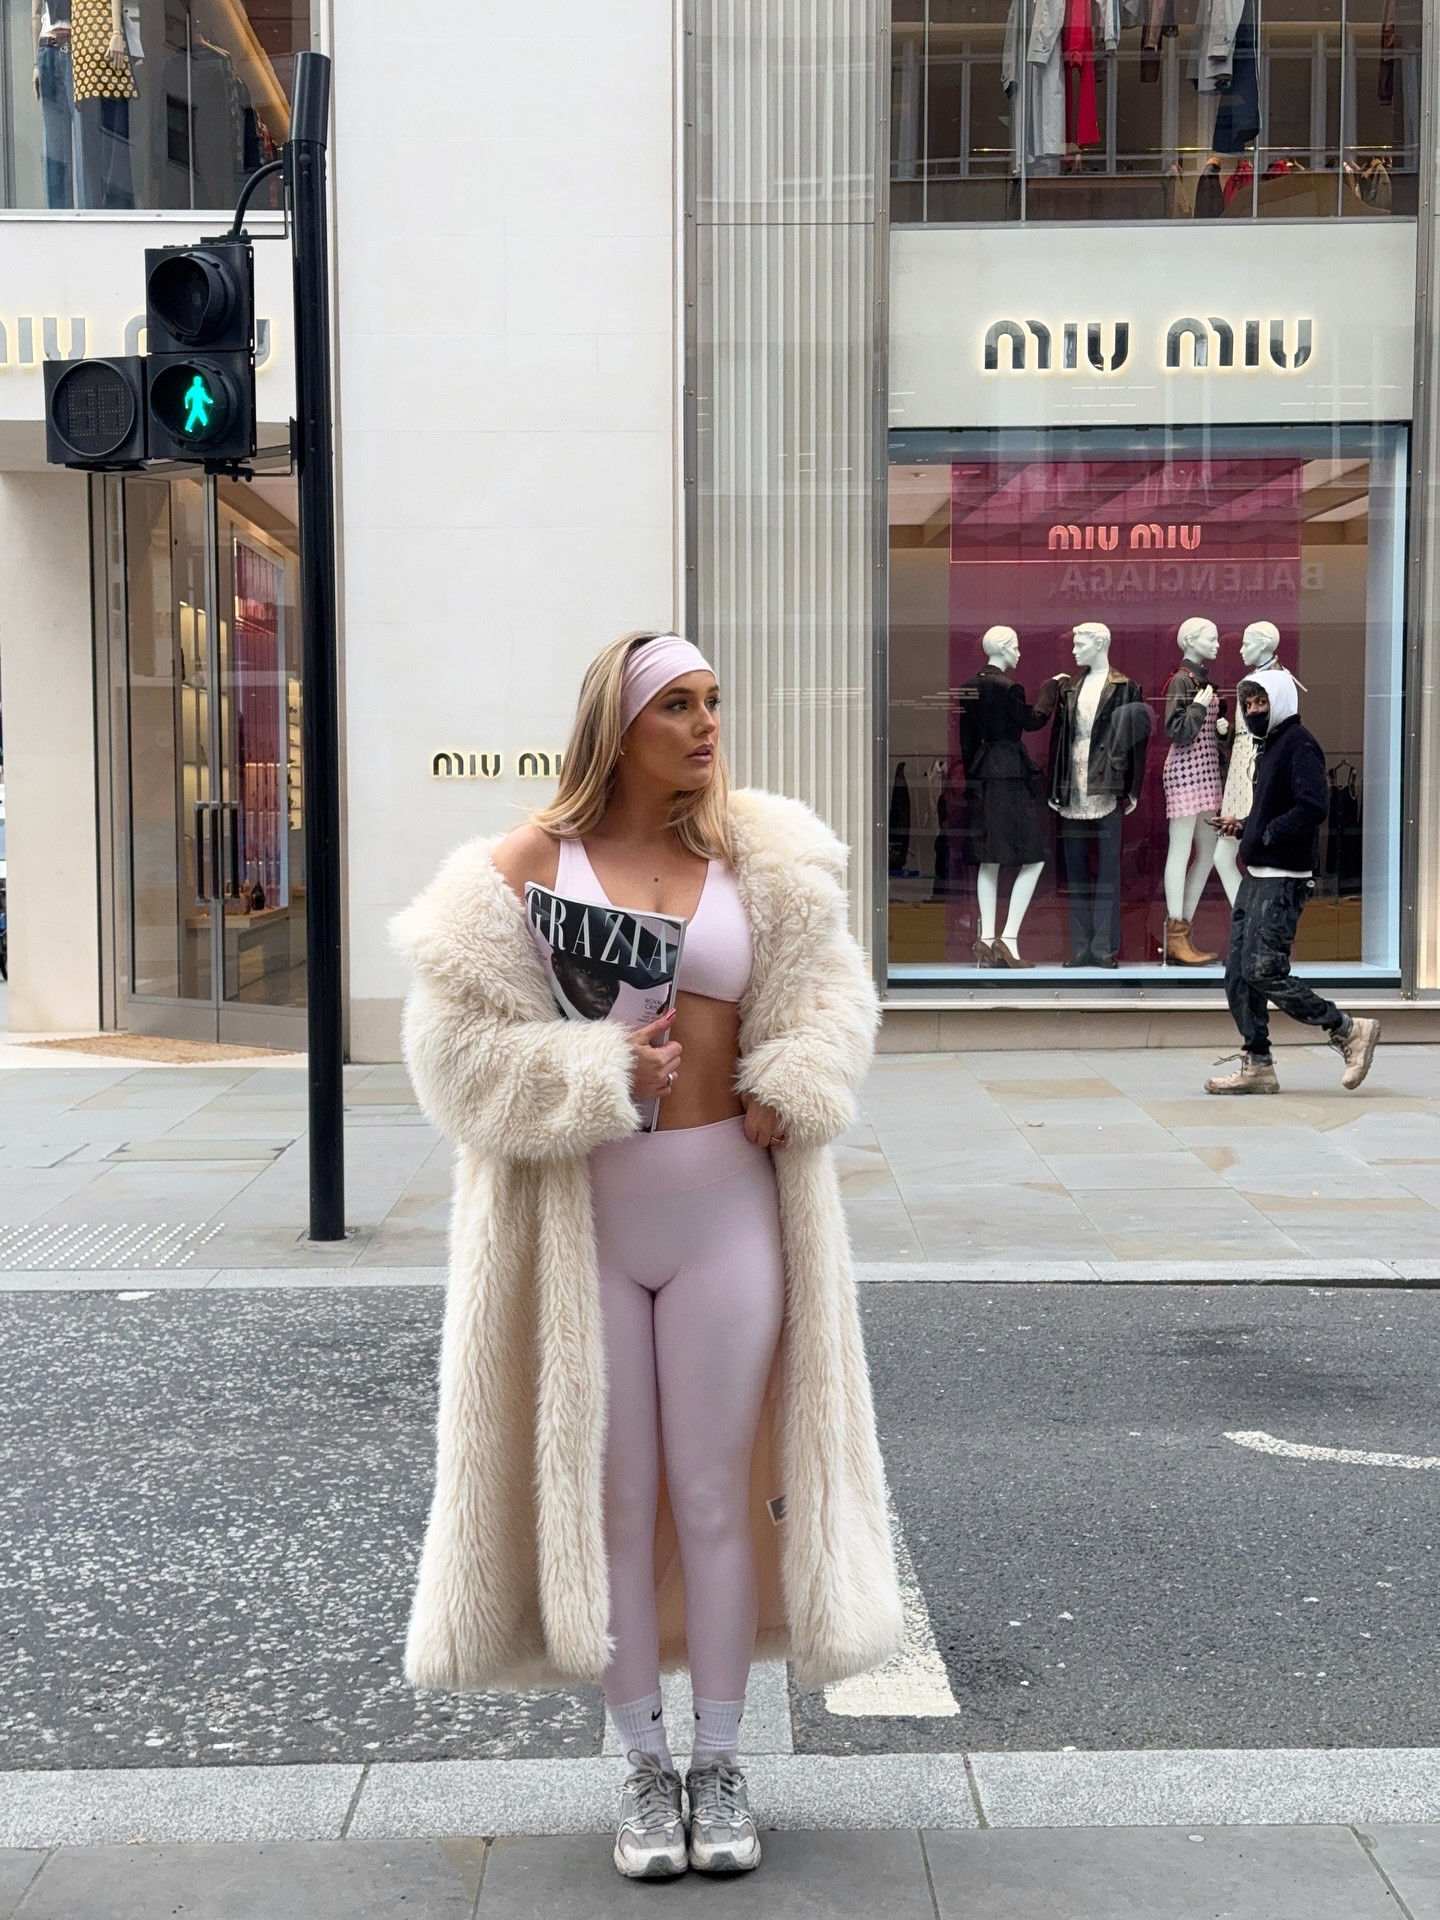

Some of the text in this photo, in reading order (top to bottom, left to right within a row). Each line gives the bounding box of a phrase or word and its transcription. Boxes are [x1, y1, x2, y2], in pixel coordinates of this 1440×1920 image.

[0, 316, 87, 364] IU
[518, 752, 562, 777] MI
[525, 888, 669, 975] GRAZIA
